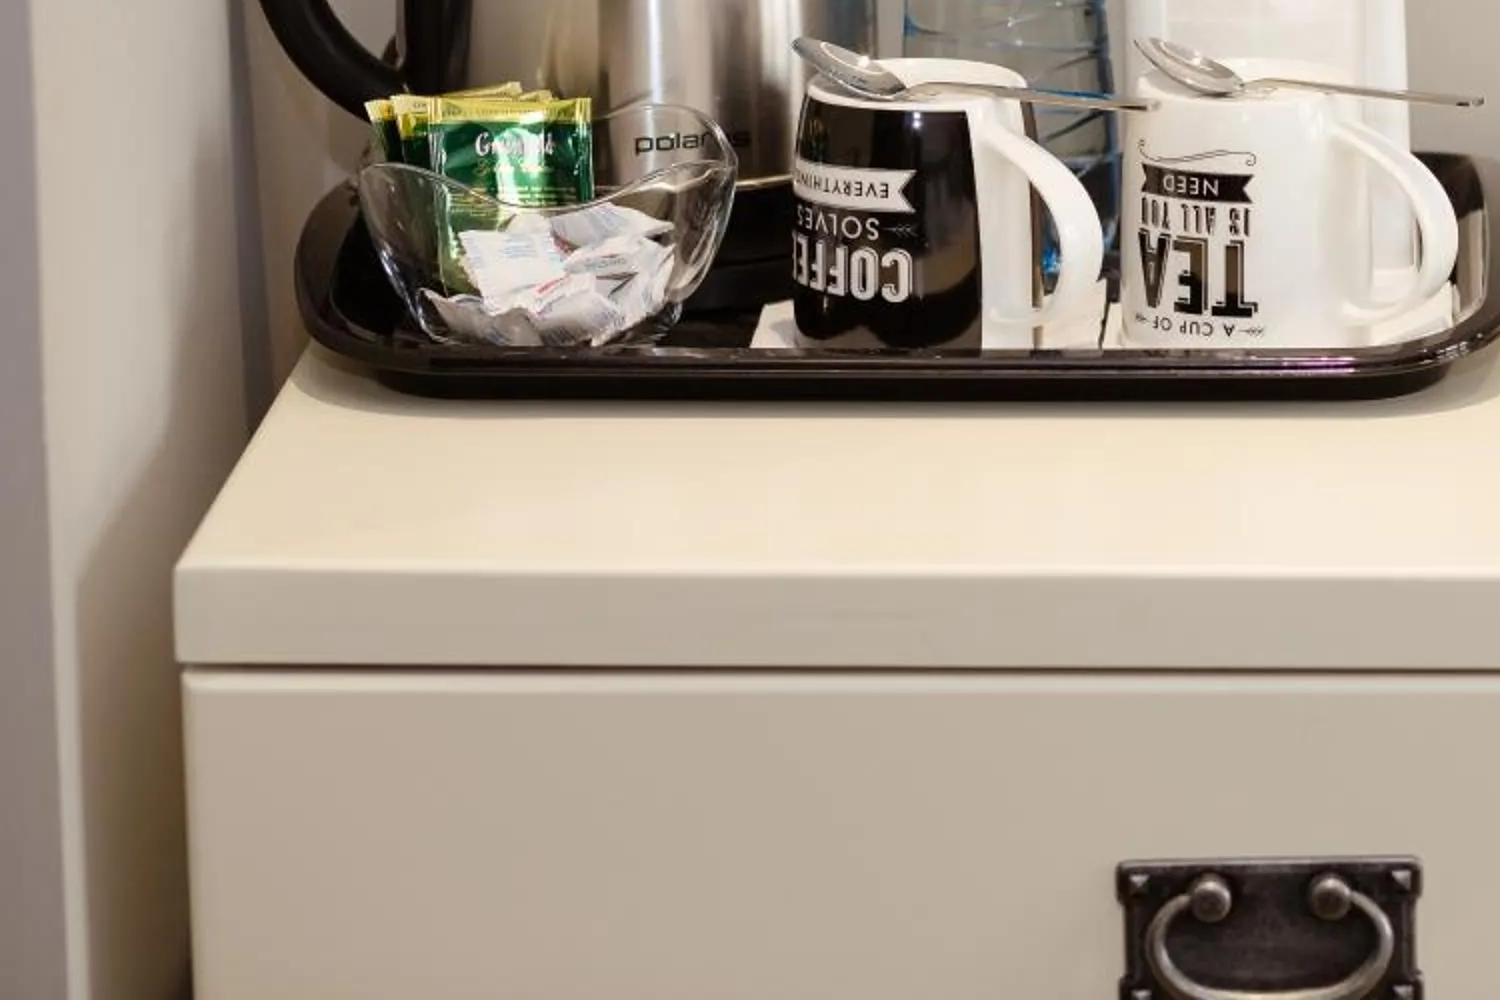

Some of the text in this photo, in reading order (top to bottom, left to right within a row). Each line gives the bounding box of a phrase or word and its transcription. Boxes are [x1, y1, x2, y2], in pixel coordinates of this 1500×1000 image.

[634, 130, 751, 156] polars
[1163, 173, 1219, 197] NEED
[797, 203, 880, 240] SOLVES
[1141, 196, 1250, 237] IS ALL YOU
[1138, 227, 1259, 318] TEA
[1152, 315, 1235, 337] A CUP OF
